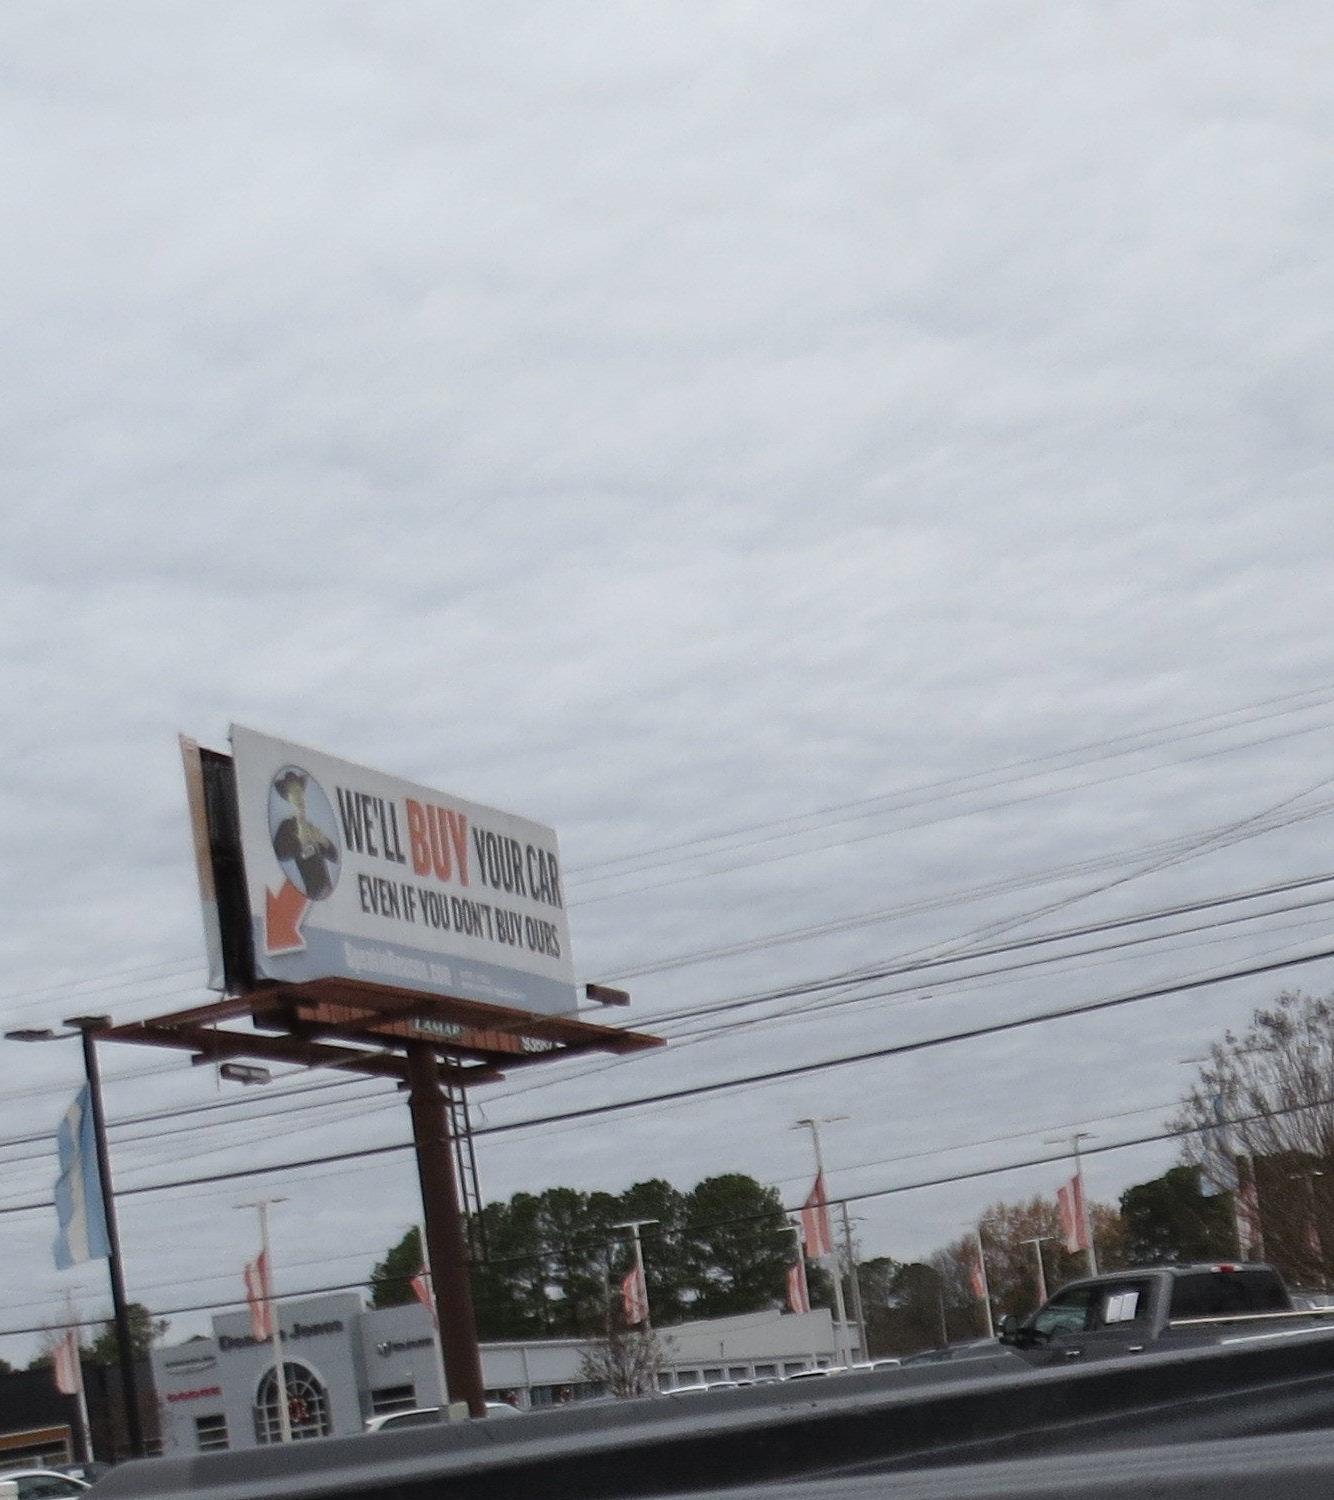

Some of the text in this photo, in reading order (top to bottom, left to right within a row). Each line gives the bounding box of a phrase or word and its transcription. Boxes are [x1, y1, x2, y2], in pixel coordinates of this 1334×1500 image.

[336, 787, 563, 909] WE'LL BUY YOUR CAR
[358, 874, 562, 960] EVEN IF YOU DON'T BUY OURS
